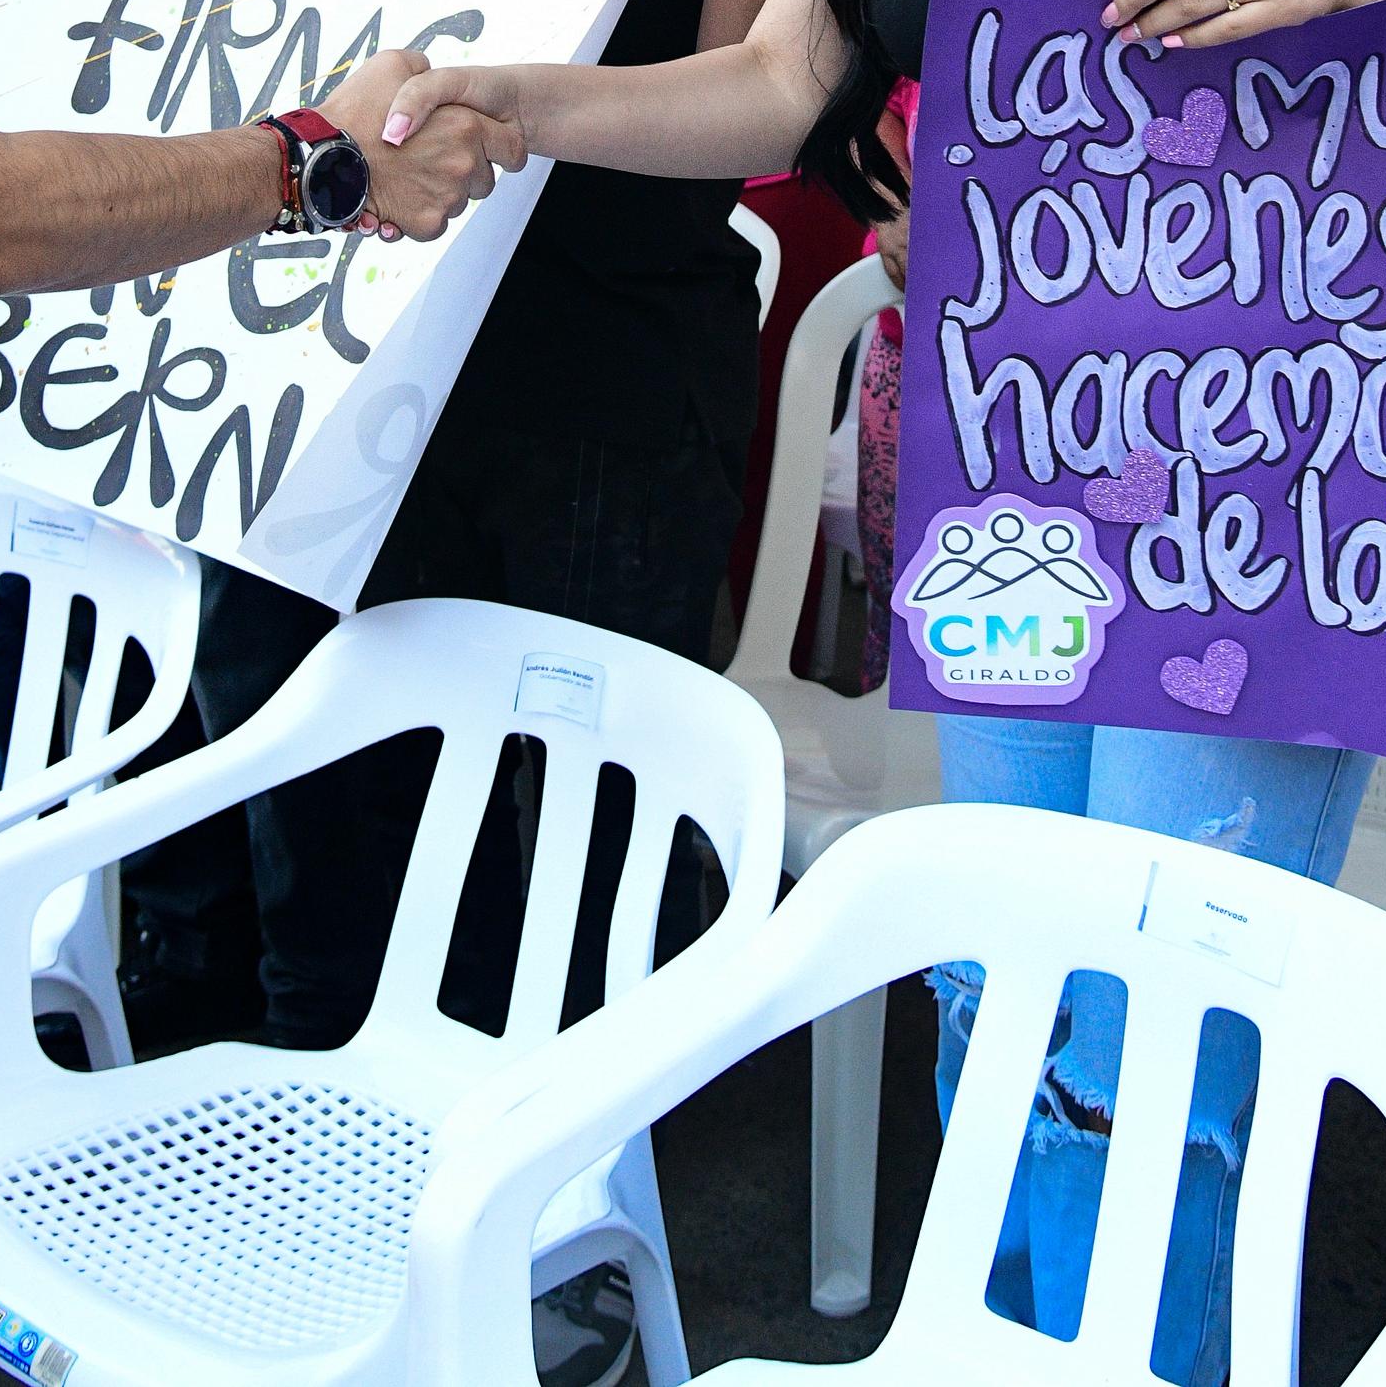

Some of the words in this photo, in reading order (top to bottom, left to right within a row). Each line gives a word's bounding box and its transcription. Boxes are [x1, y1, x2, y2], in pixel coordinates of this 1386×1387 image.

[1127, 453, 1289, 614] de
[929, 614, 1085, 657] CMJ
[949, 668, 1071, 681] GIRALDO
[1205, 900, 1248, 923] Reservado
